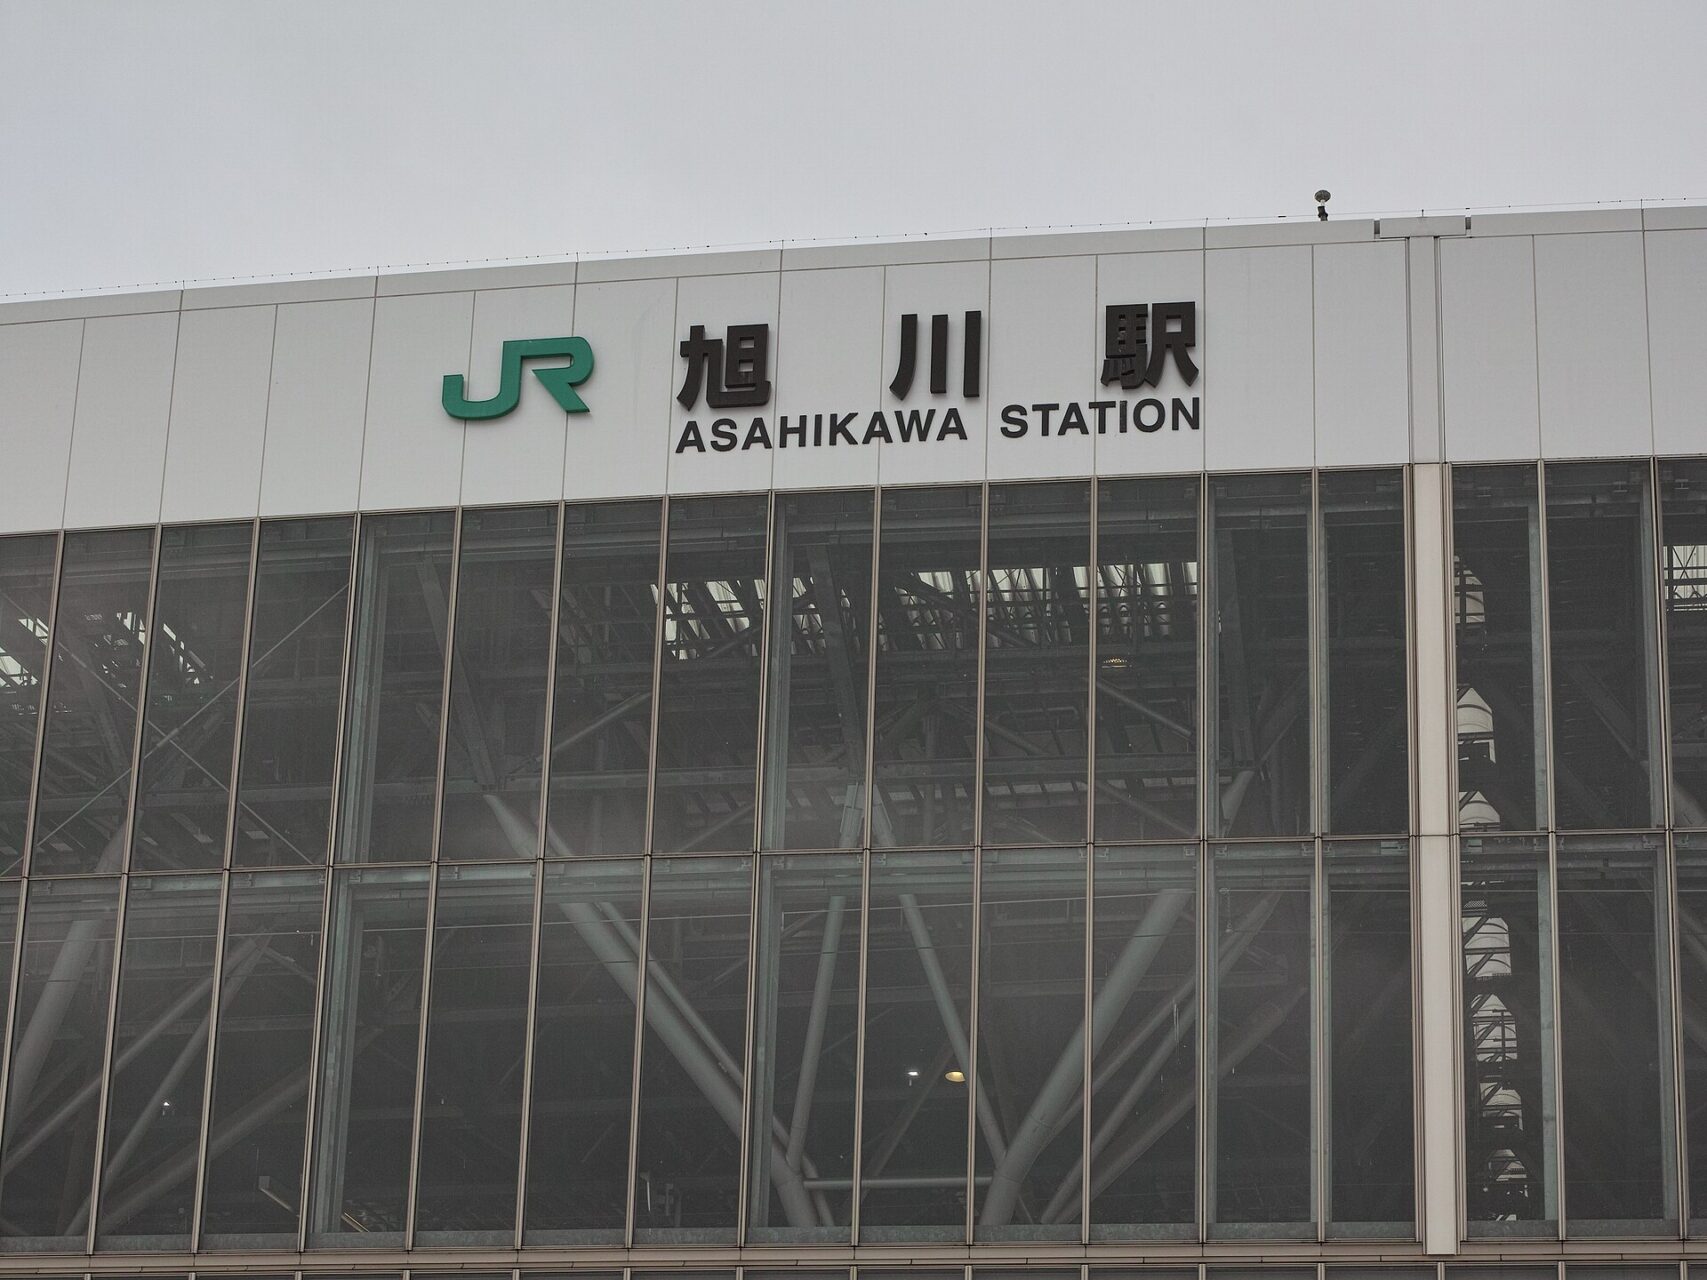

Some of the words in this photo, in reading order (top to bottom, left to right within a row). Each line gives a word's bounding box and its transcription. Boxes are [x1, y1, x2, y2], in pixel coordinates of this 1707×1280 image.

[442, 337, 595, 420] JR
[677, 302, 1199, 412] 旭川駅
[676, 409, 967, 454] ASAHIKAWA
[1001, 397, 1199, 439] STATION
